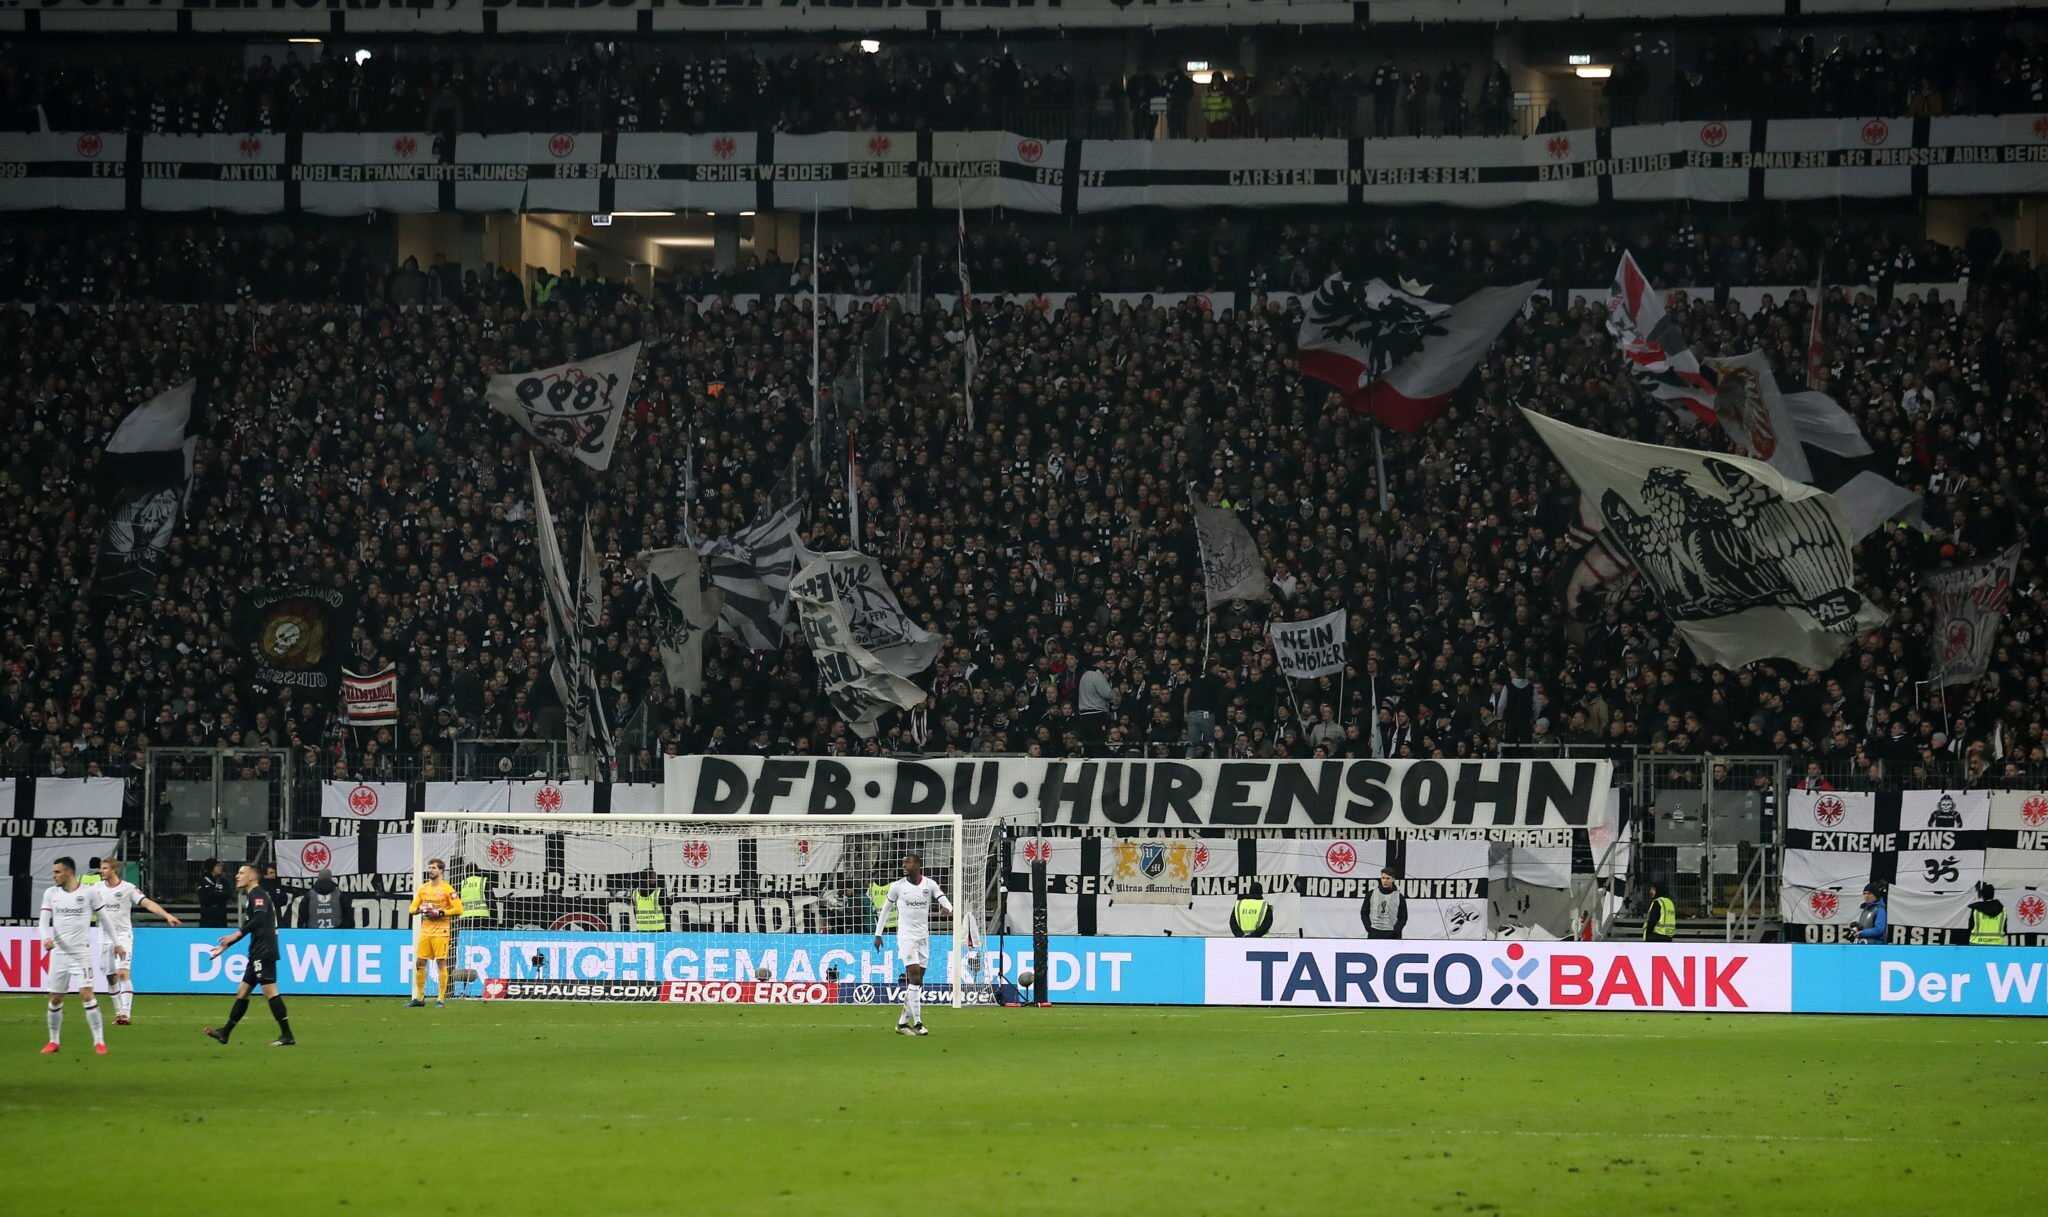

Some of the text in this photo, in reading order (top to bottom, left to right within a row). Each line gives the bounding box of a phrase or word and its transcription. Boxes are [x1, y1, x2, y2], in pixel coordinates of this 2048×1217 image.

[92, 162, 125, 176] EFC
[220, 164, 278, 180] ANTON
[848, 162, 879, 177] EFC
[883, 162, 910, 177] DIE
[1229, 168, 1480, 185] CARSTEN UNVERGESSEN
[1538, 164, 1573, 181] BAD
[1280, 623, 1333, 649] NEIN
[1038, 760, 1597, 826] HURENSOHN
[329, 819, 361, 838] THE
[1811, 831, 1956, 852] EXTREME FANS
[498, 871, 608, 891] NORDEND
[665, 873, 822, 895] VILBEL CREW
[188, 942, 249, 983] De
[269, 943, 383, 983] WIE
[510, 946, 648, 981] MICH
[1246, 950, 1750, 1008] TARGO BANK
[1880, 961, 1971, 1003] Der
[507, 984, 658, 997] STRAUSS.COM
[668, 981, 743, 1003] ERGO
[753, 982, 828, 1004] ERGO
